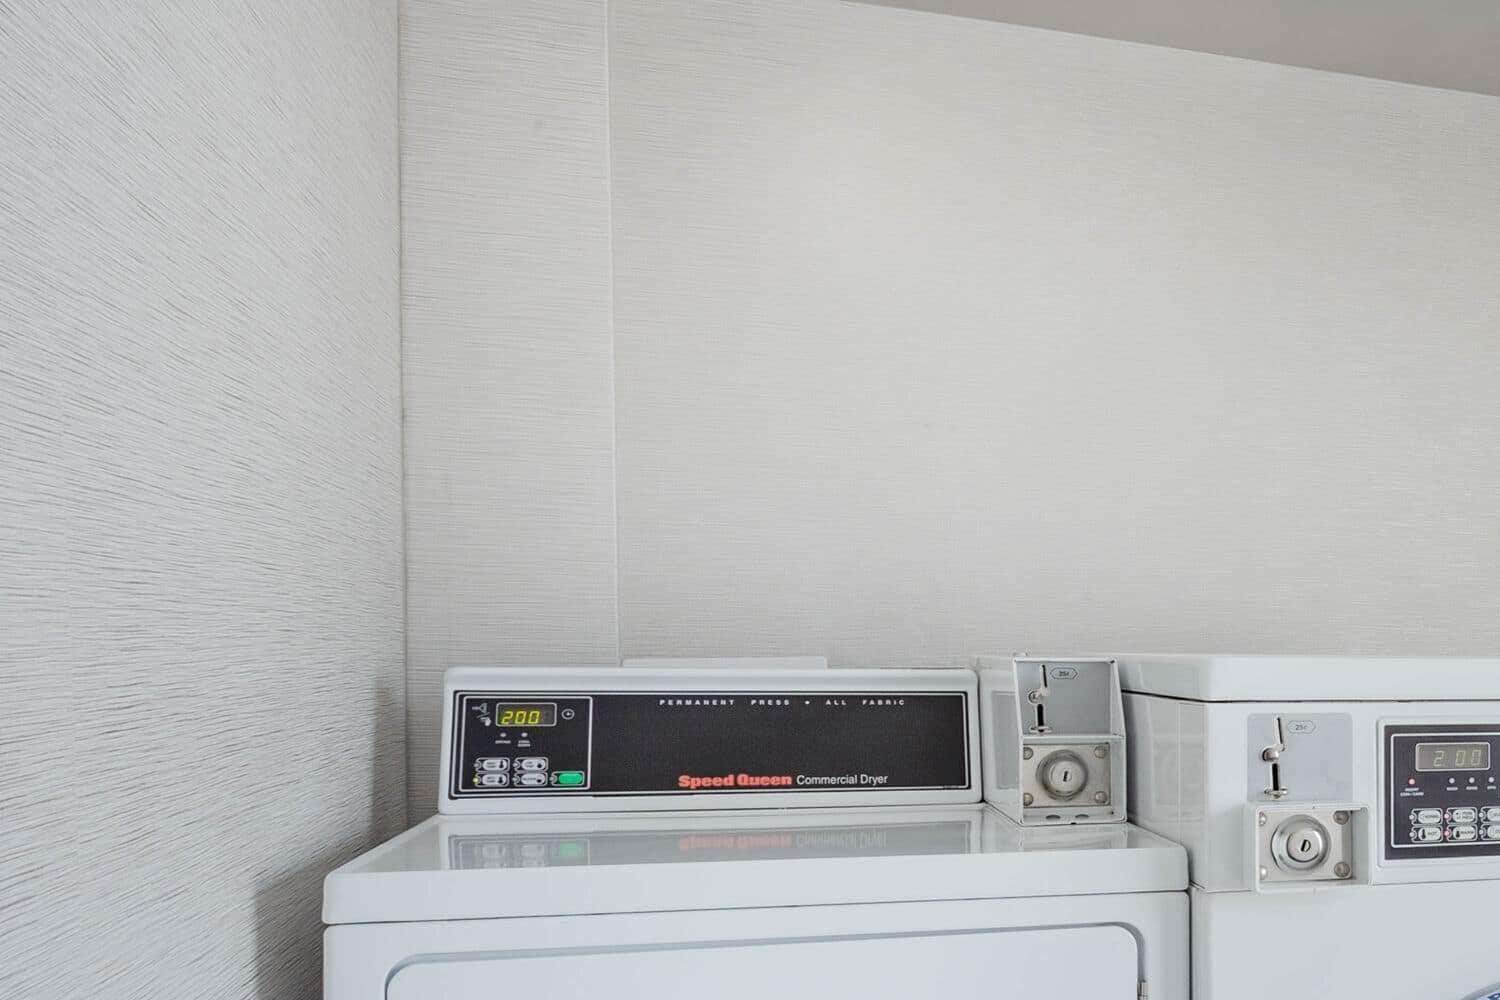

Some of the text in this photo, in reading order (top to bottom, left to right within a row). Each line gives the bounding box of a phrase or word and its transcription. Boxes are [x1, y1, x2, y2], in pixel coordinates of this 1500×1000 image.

[501, 711, 540, 725] 200
[678, 774, 889, 789] Speed Queen Commercial Dryer
